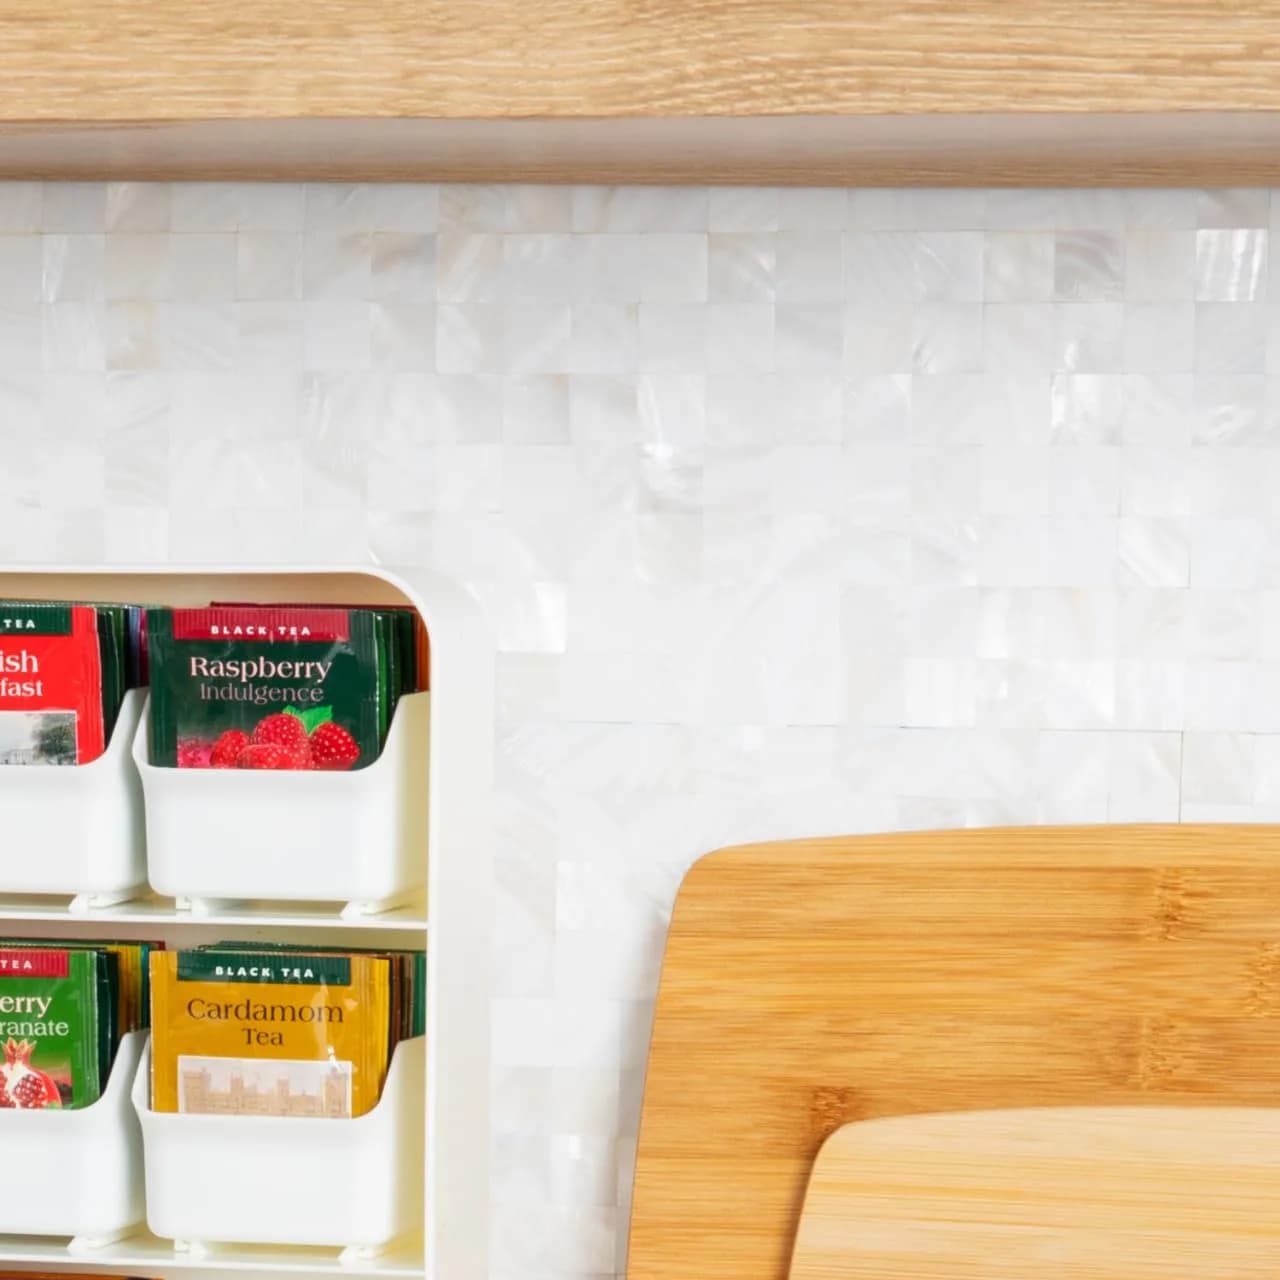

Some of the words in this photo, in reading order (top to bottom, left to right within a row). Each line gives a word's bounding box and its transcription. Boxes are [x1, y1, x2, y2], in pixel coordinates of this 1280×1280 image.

[4, 619, 36, 629] TEA
[211, 625, 267, 635] BLACK
[278, 626, 311, 636] TEA
[190, 656, 332, 682] Raspberry
[200, 683, 324, 705] Indulgence
[0, 960, 32, 969] TEA
[215, 966, 271, 976] BLACK
[281, 968, 314, 978] TEA
[187, 998, 344, 1023] Cardamom
[242, 1028, 284, 1046] Tea
